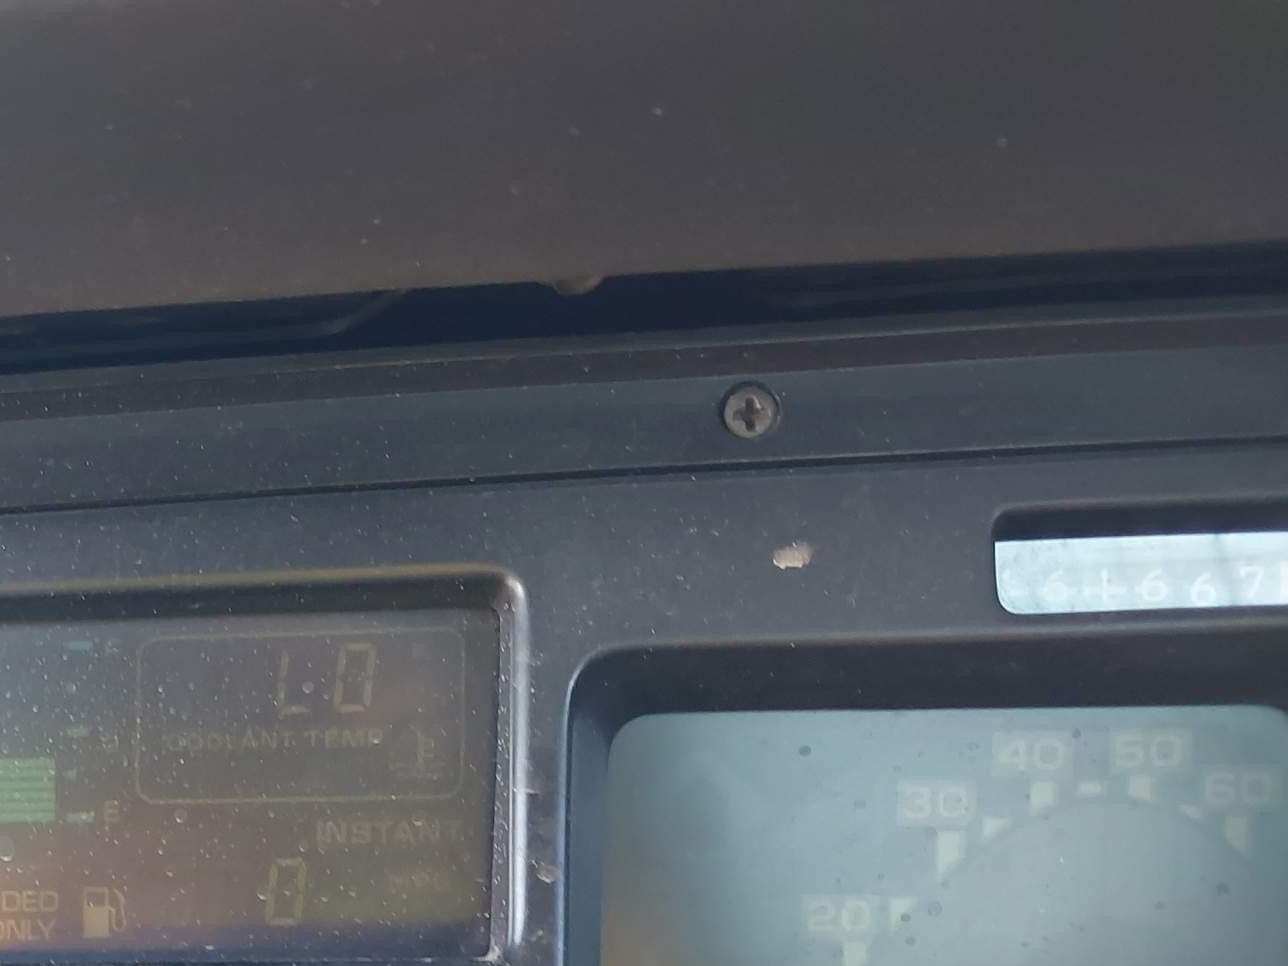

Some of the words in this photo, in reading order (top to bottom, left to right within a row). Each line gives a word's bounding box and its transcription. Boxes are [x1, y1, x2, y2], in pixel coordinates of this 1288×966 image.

[161, 729, 294, 753] COOLANT
[307, 727, 387, 749] TEMP
[998, 738, 1066, 771] 40
[1114, 732, 1182, 768] 50
[901, 786, 969, 819] 30
[1203, 770, 1273, 805] 60
[316, 820, 462, 845] INSTANT
[265, 858, 307, 927] 0
[807, 901, 873, 933] 20
